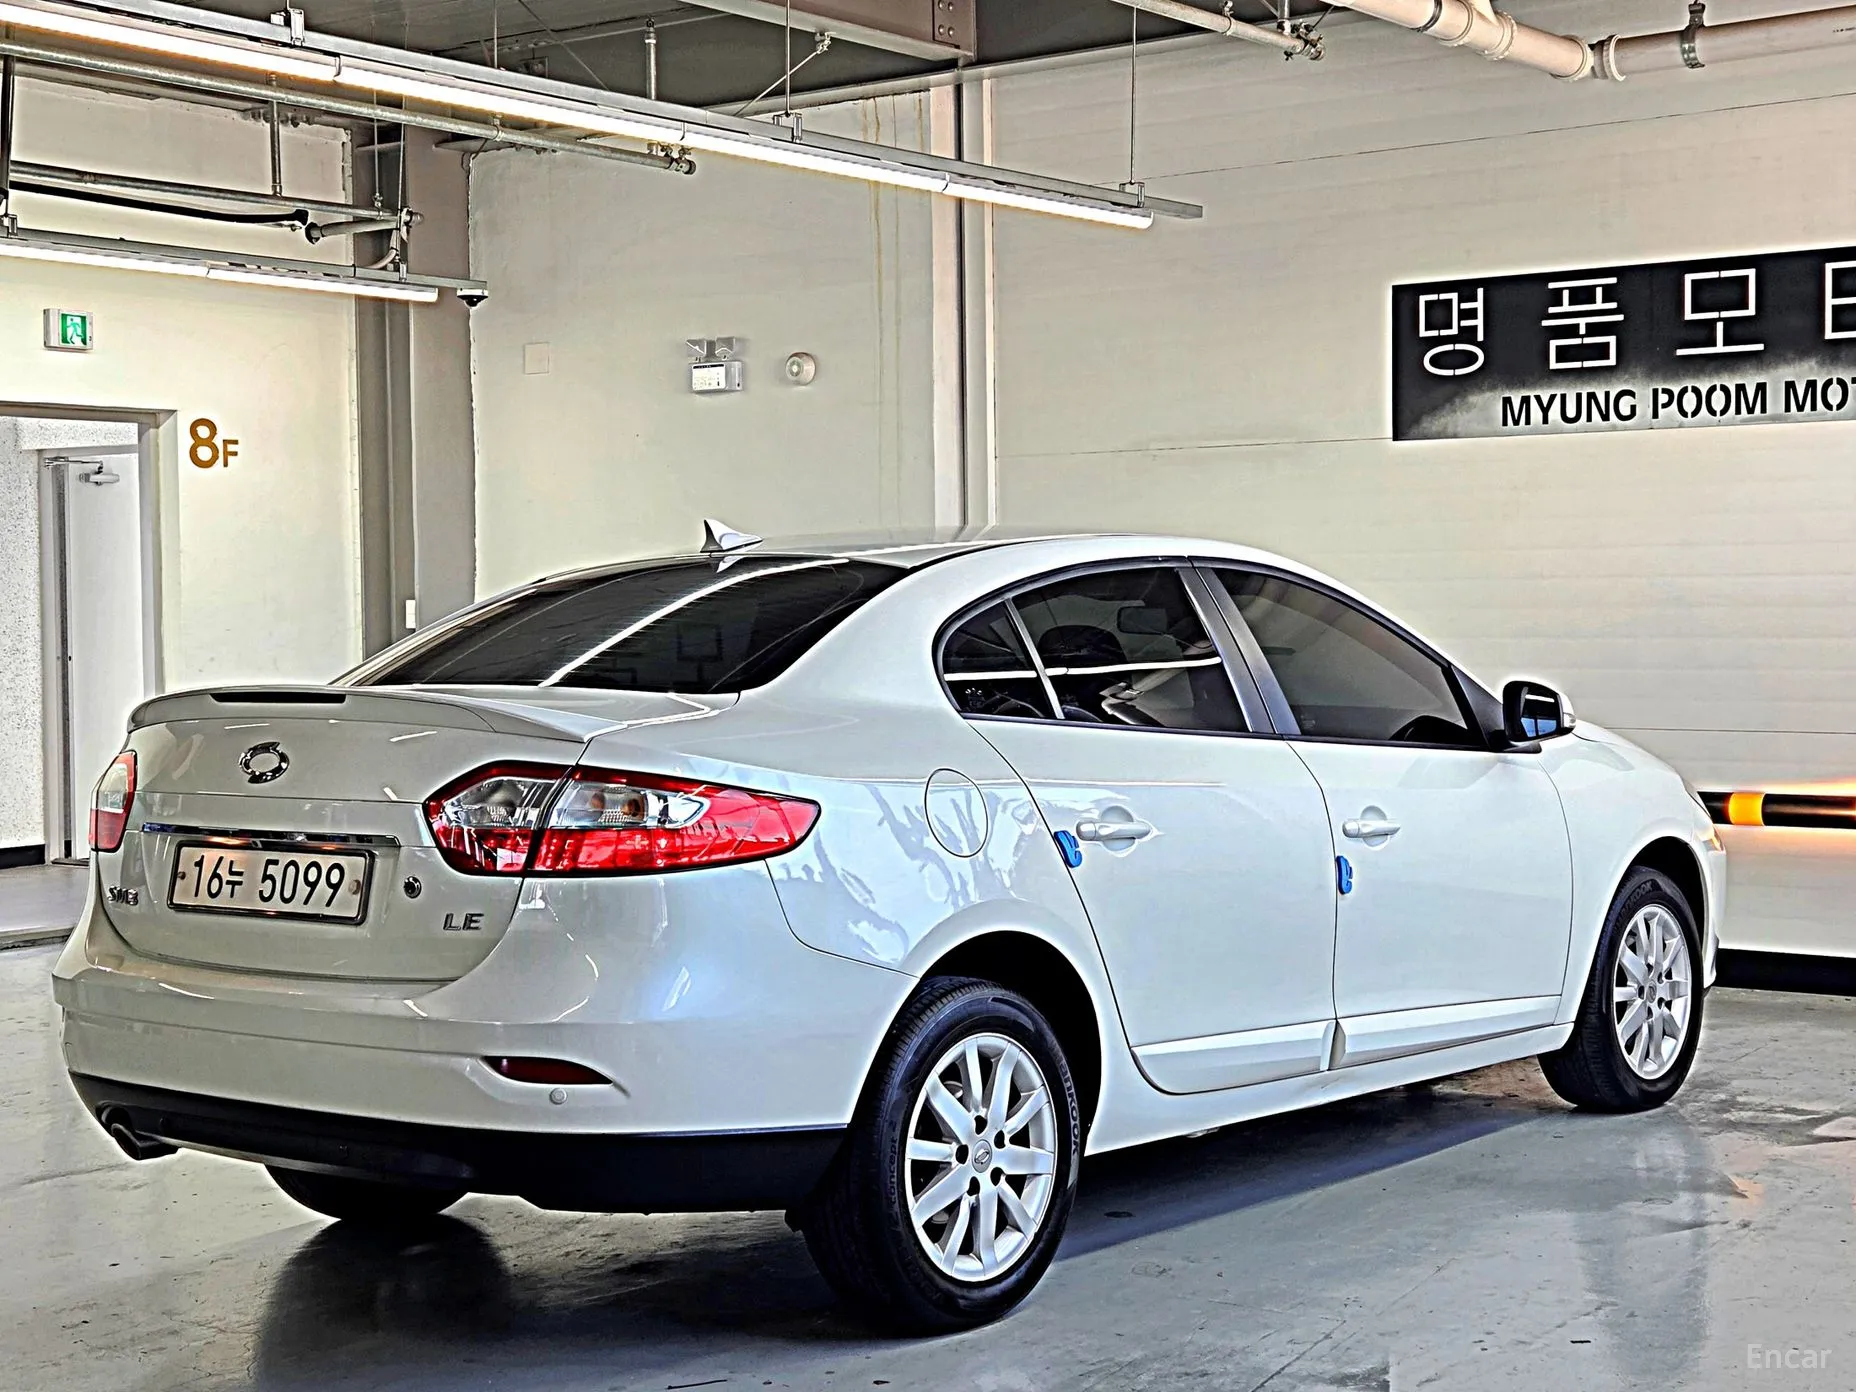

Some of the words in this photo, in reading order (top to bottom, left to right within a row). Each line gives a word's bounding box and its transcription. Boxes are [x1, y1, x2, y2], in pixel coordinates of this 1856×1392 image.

[1501, 389, 1637, 427] MYUNG
[1651, 381, 1767, 419] POOM
[1784, 377, 1856, 413] MO
[189, 418, 239, 469] 8F
[194, 854, 244, 899] 16누
[258, 858, 346, 908] 5099
[443, 912, 484, 931] LE
